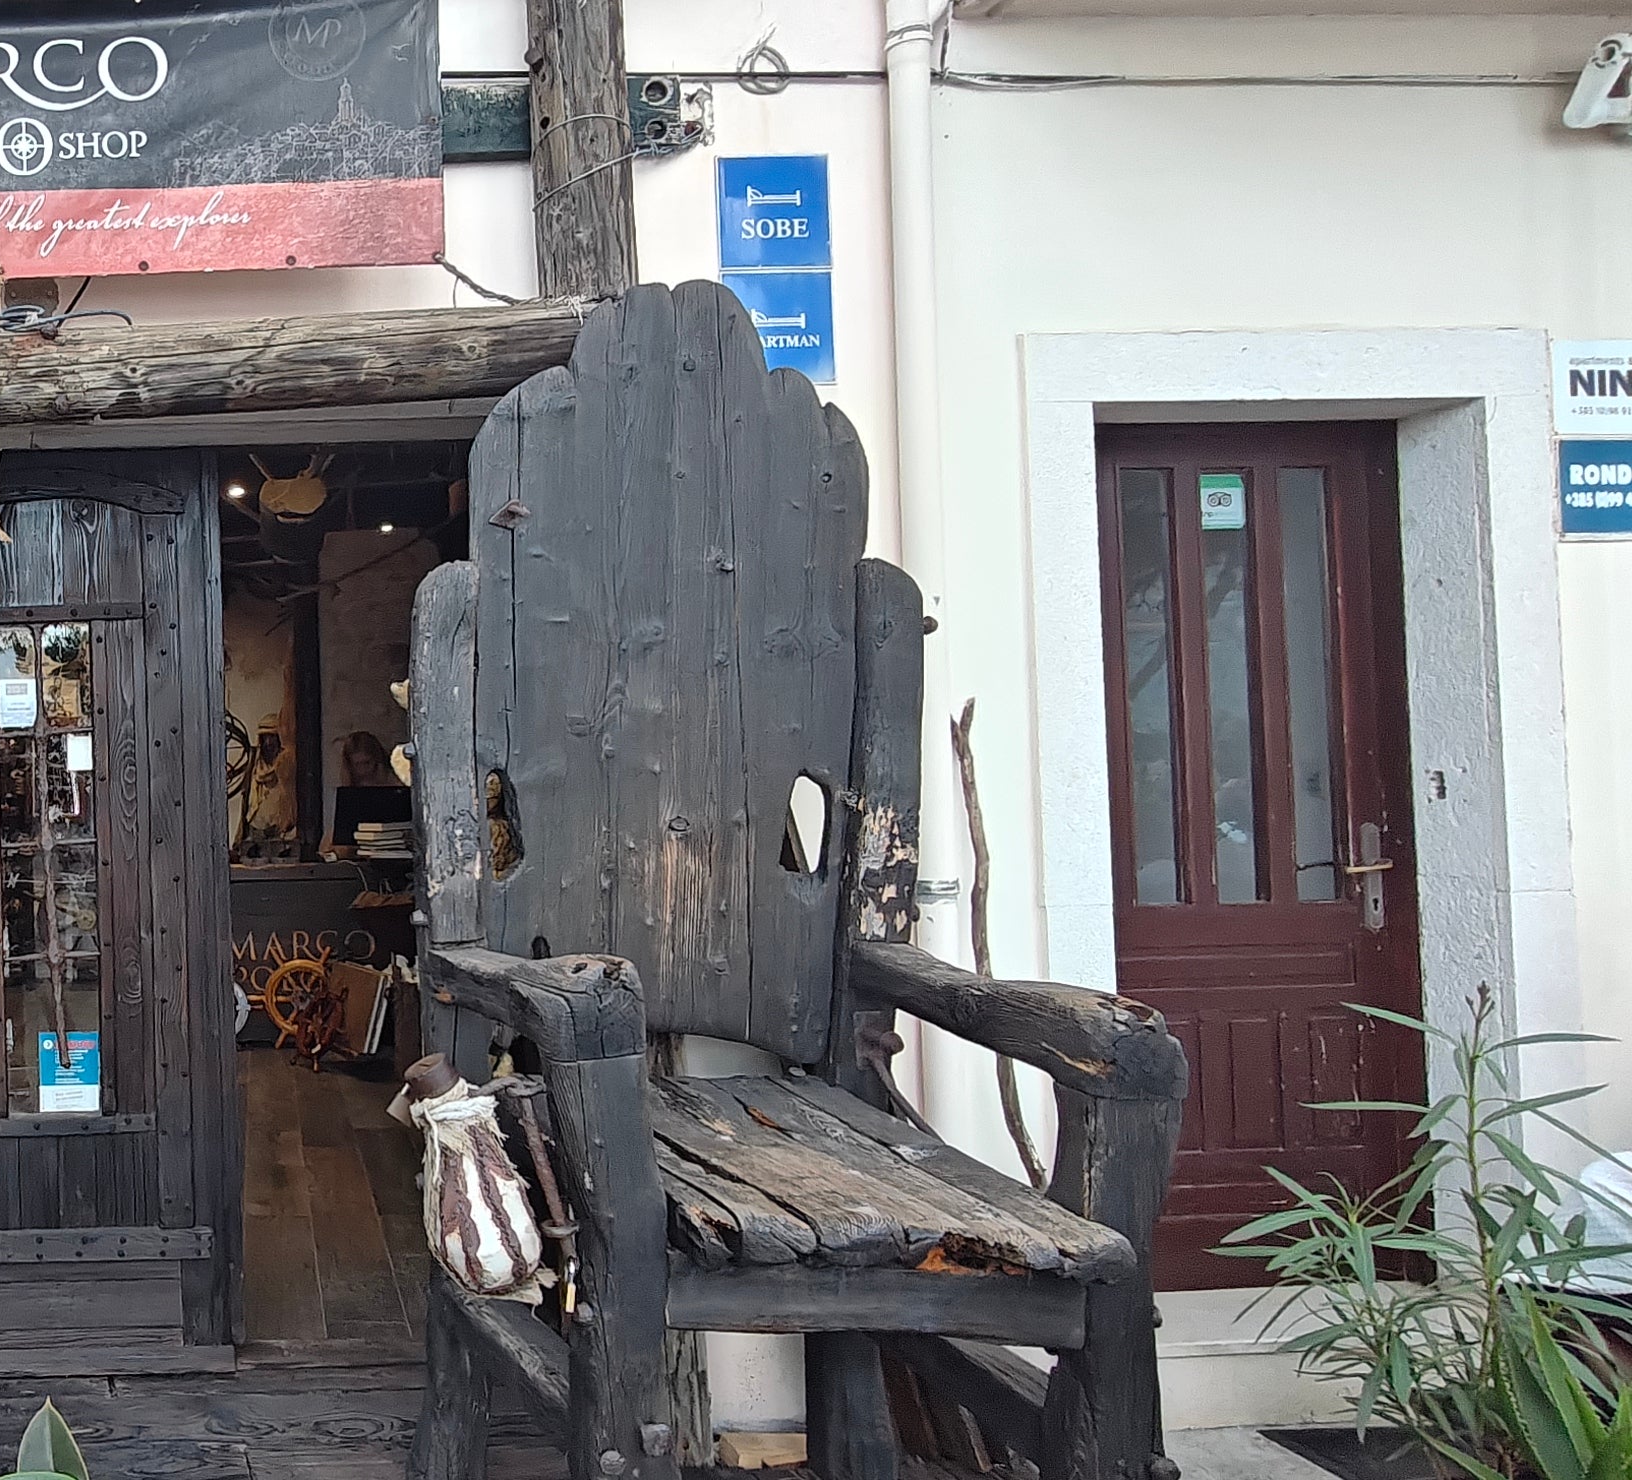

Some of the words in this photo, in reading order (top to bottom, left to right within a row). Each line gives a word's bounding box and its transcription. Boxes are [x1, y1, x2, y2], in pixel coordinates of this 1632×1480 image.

[58, 130, 148, 160] SHOP
[6, 194, 46, 233] the
[39, 199, 151, 257] greatest
[150, 191, 251, 250] explorer
[741, 218, 809, 239] SOBE
[759, 334, 820, 348] ARTMAN
[1569, 464, 1632, 486] ROND
